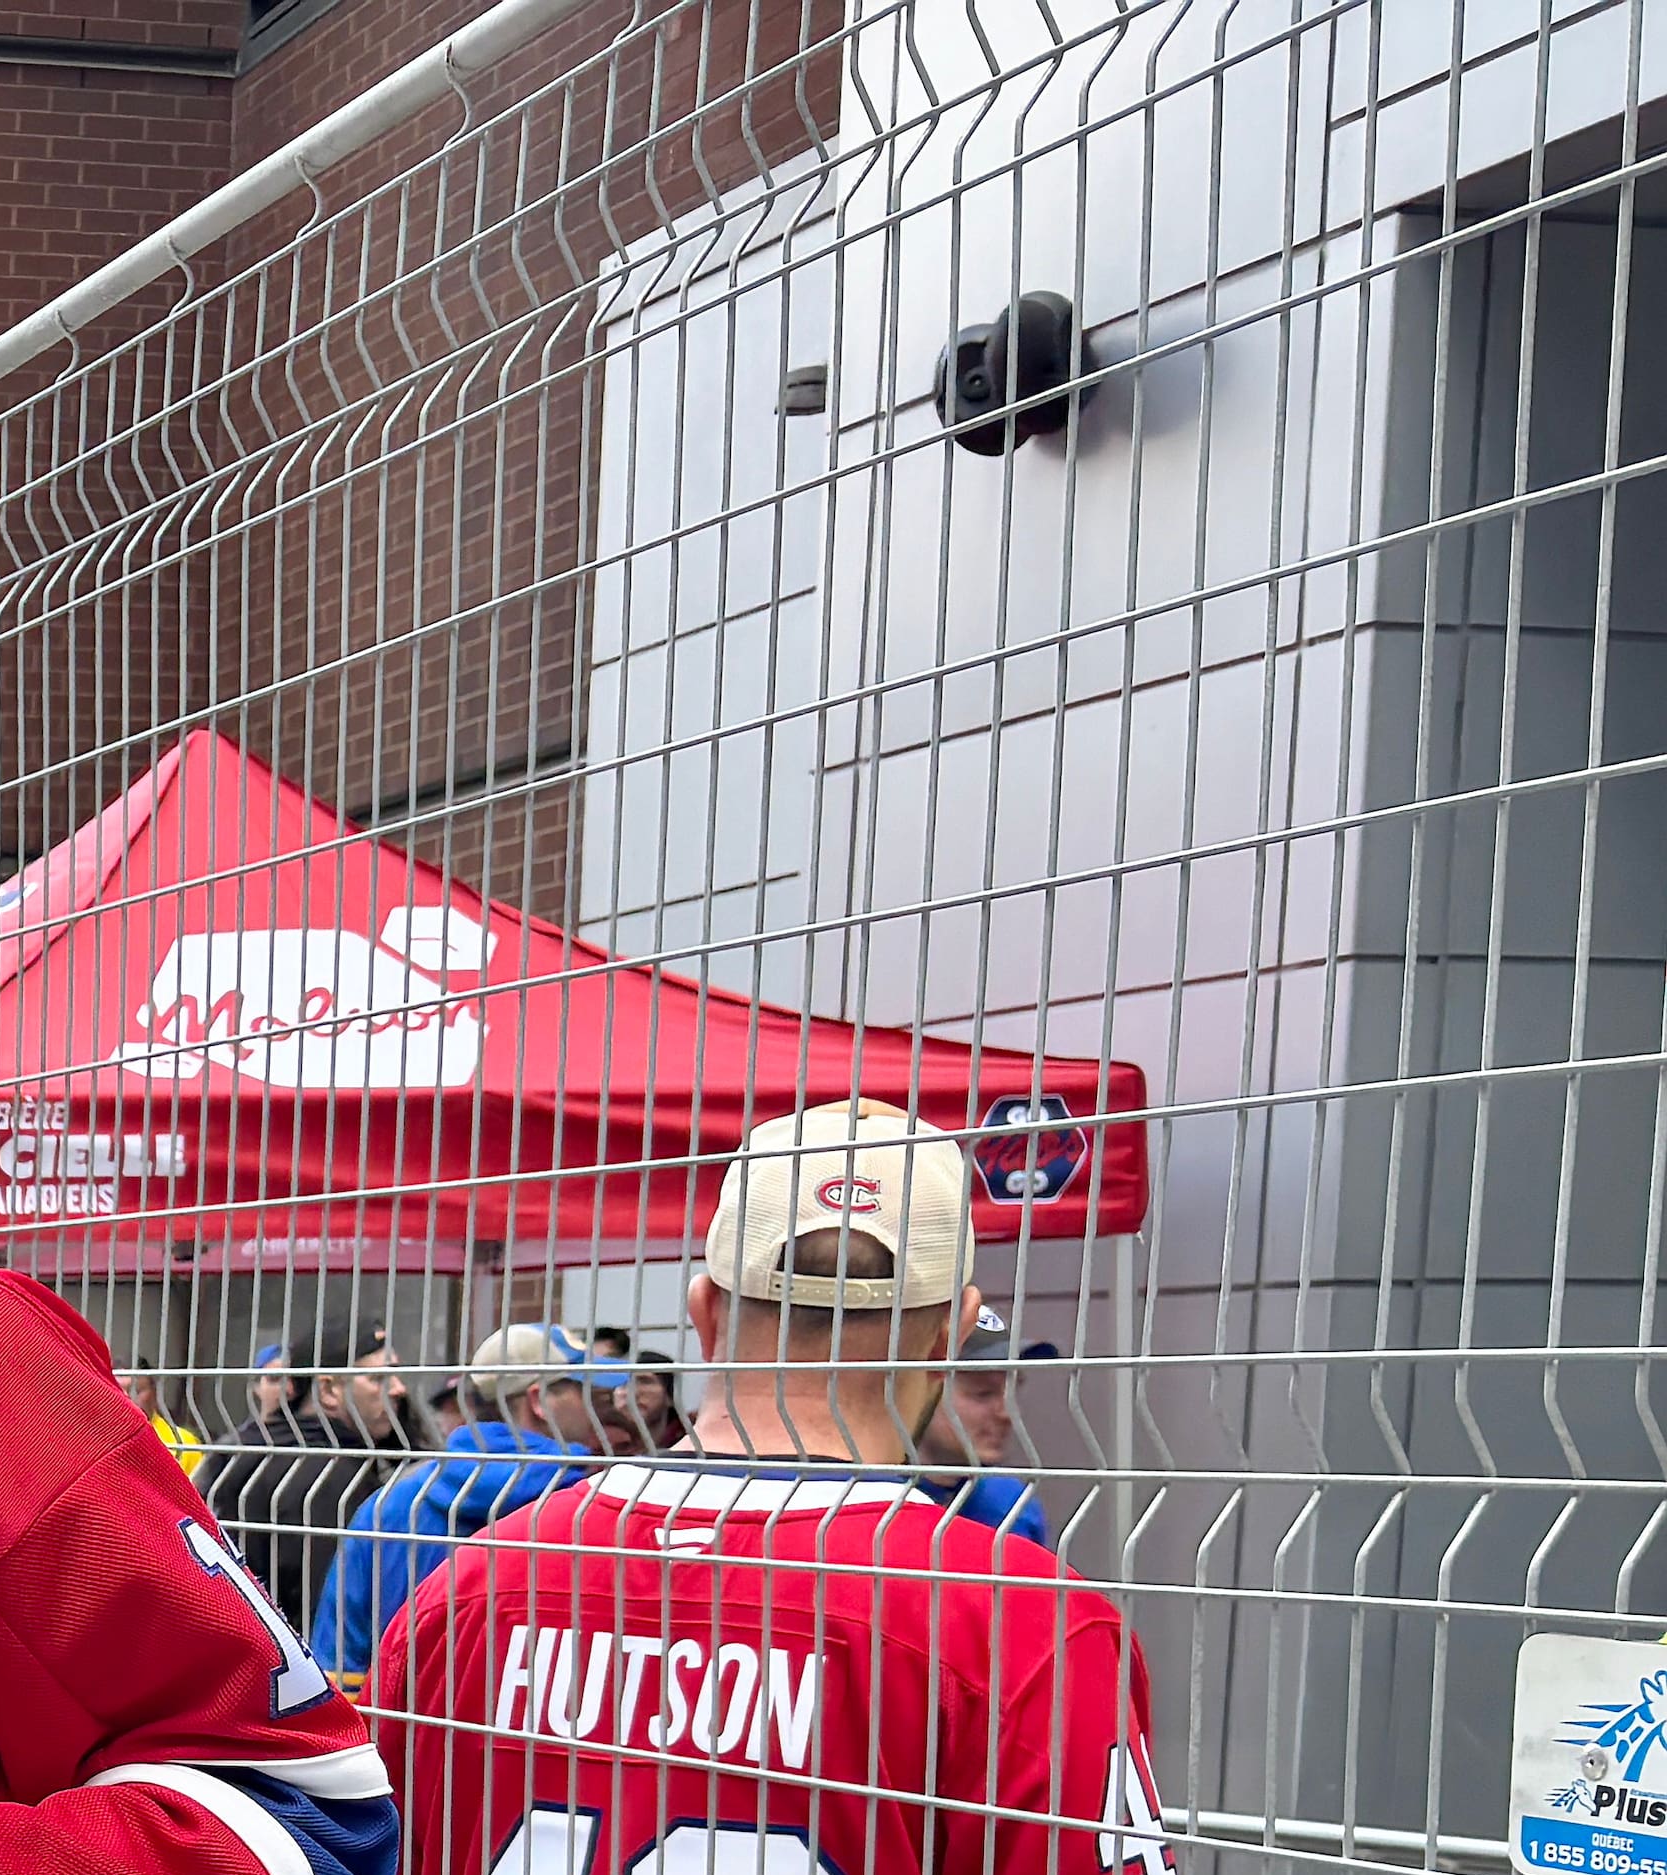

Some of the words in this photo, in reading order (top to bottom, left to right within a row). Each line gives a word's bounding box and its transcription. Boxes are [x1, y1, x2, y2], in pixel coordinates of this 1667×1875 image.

[496, 1625, 828, 1769] HUTSON
[1590, 1785, 1667, 1826] Plus
[1530, 1841, 1538, 1860] 1
[1544, 1843, 1585, 1867] 855
[1592, 1832, 1634, 1852] QUÉBEC
